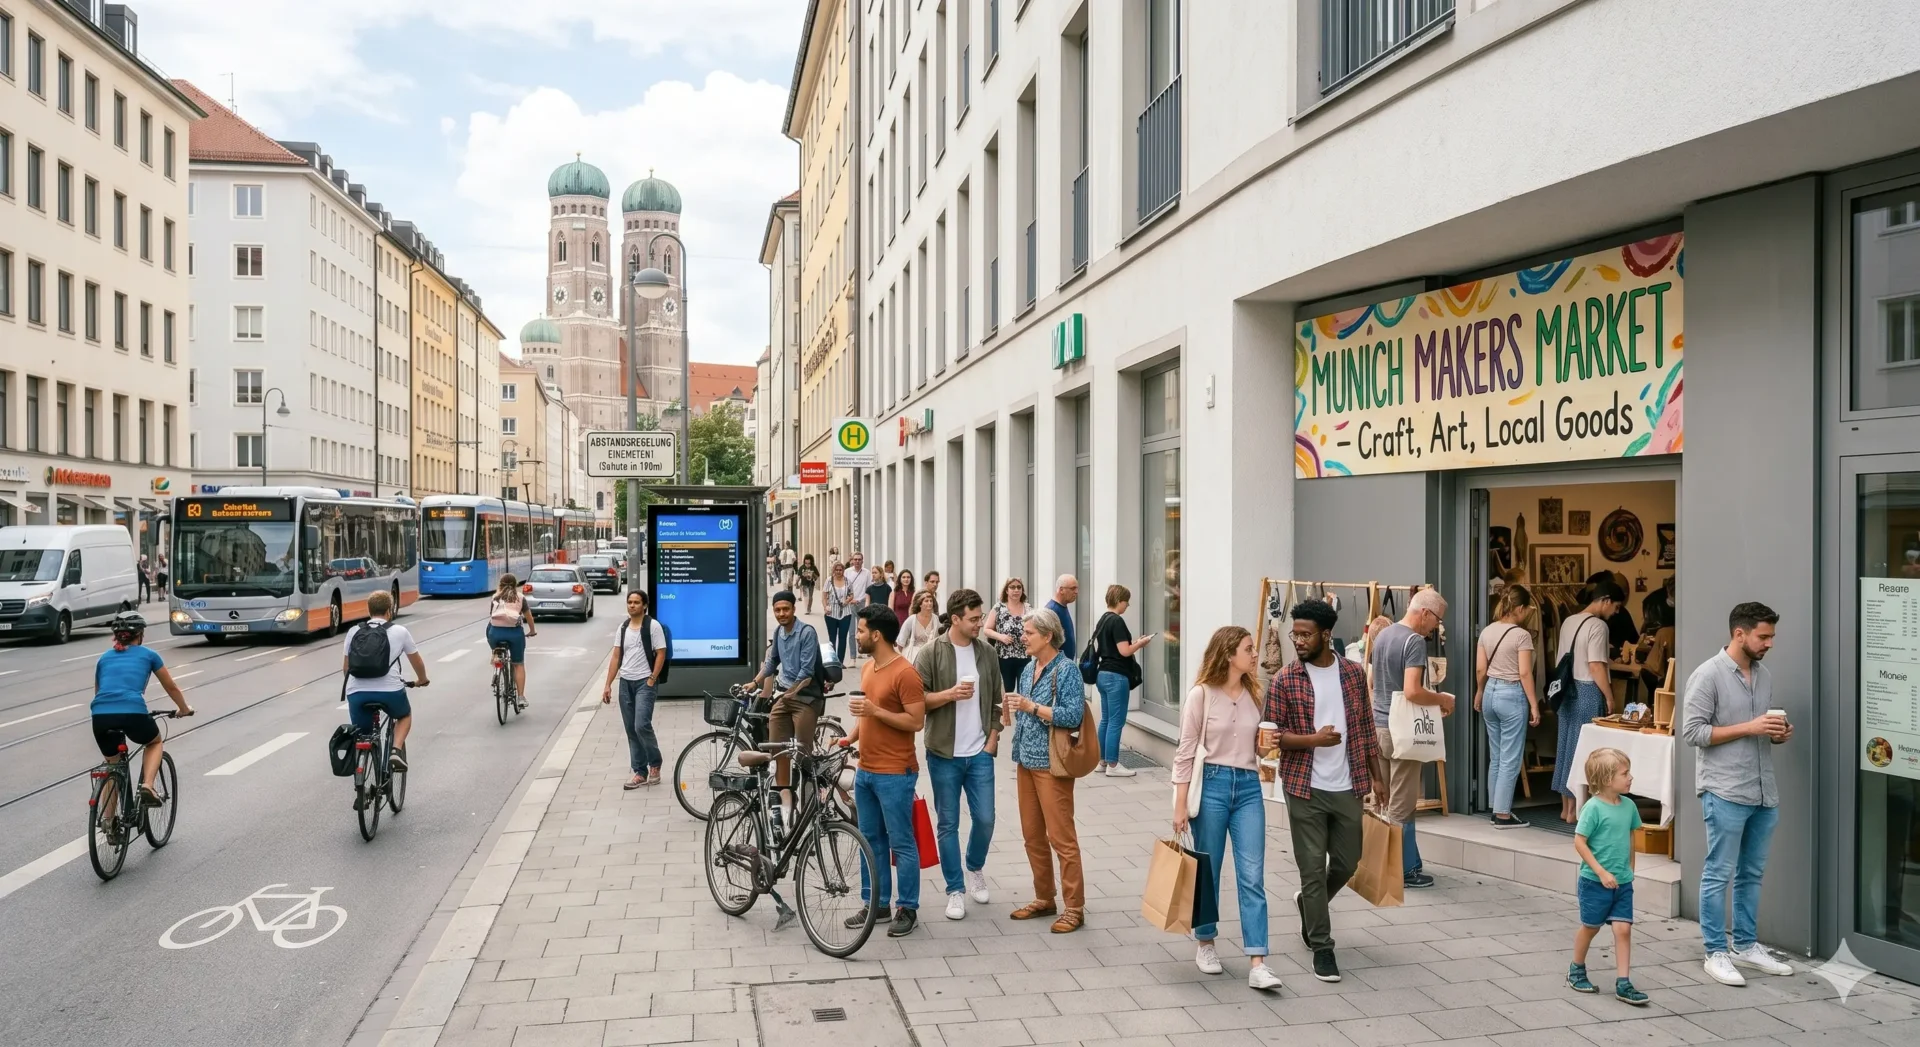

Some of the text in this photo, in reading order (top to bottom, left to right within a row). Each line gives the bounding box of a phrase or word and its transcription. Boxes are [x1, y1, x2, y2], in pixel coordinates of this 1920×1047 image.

[1311, 281, 1672, 417] MUNICH MAKERS MARKET
[847, 427, 861, 446] H
[1357, 416, 1422, 460] Craft,
[1430, 410, 1476, 454] Art,
[1485, 405, 1545, 449] Local
[1555, 390, 1634, 441] Goods
[630, 461, 637, 471] in
